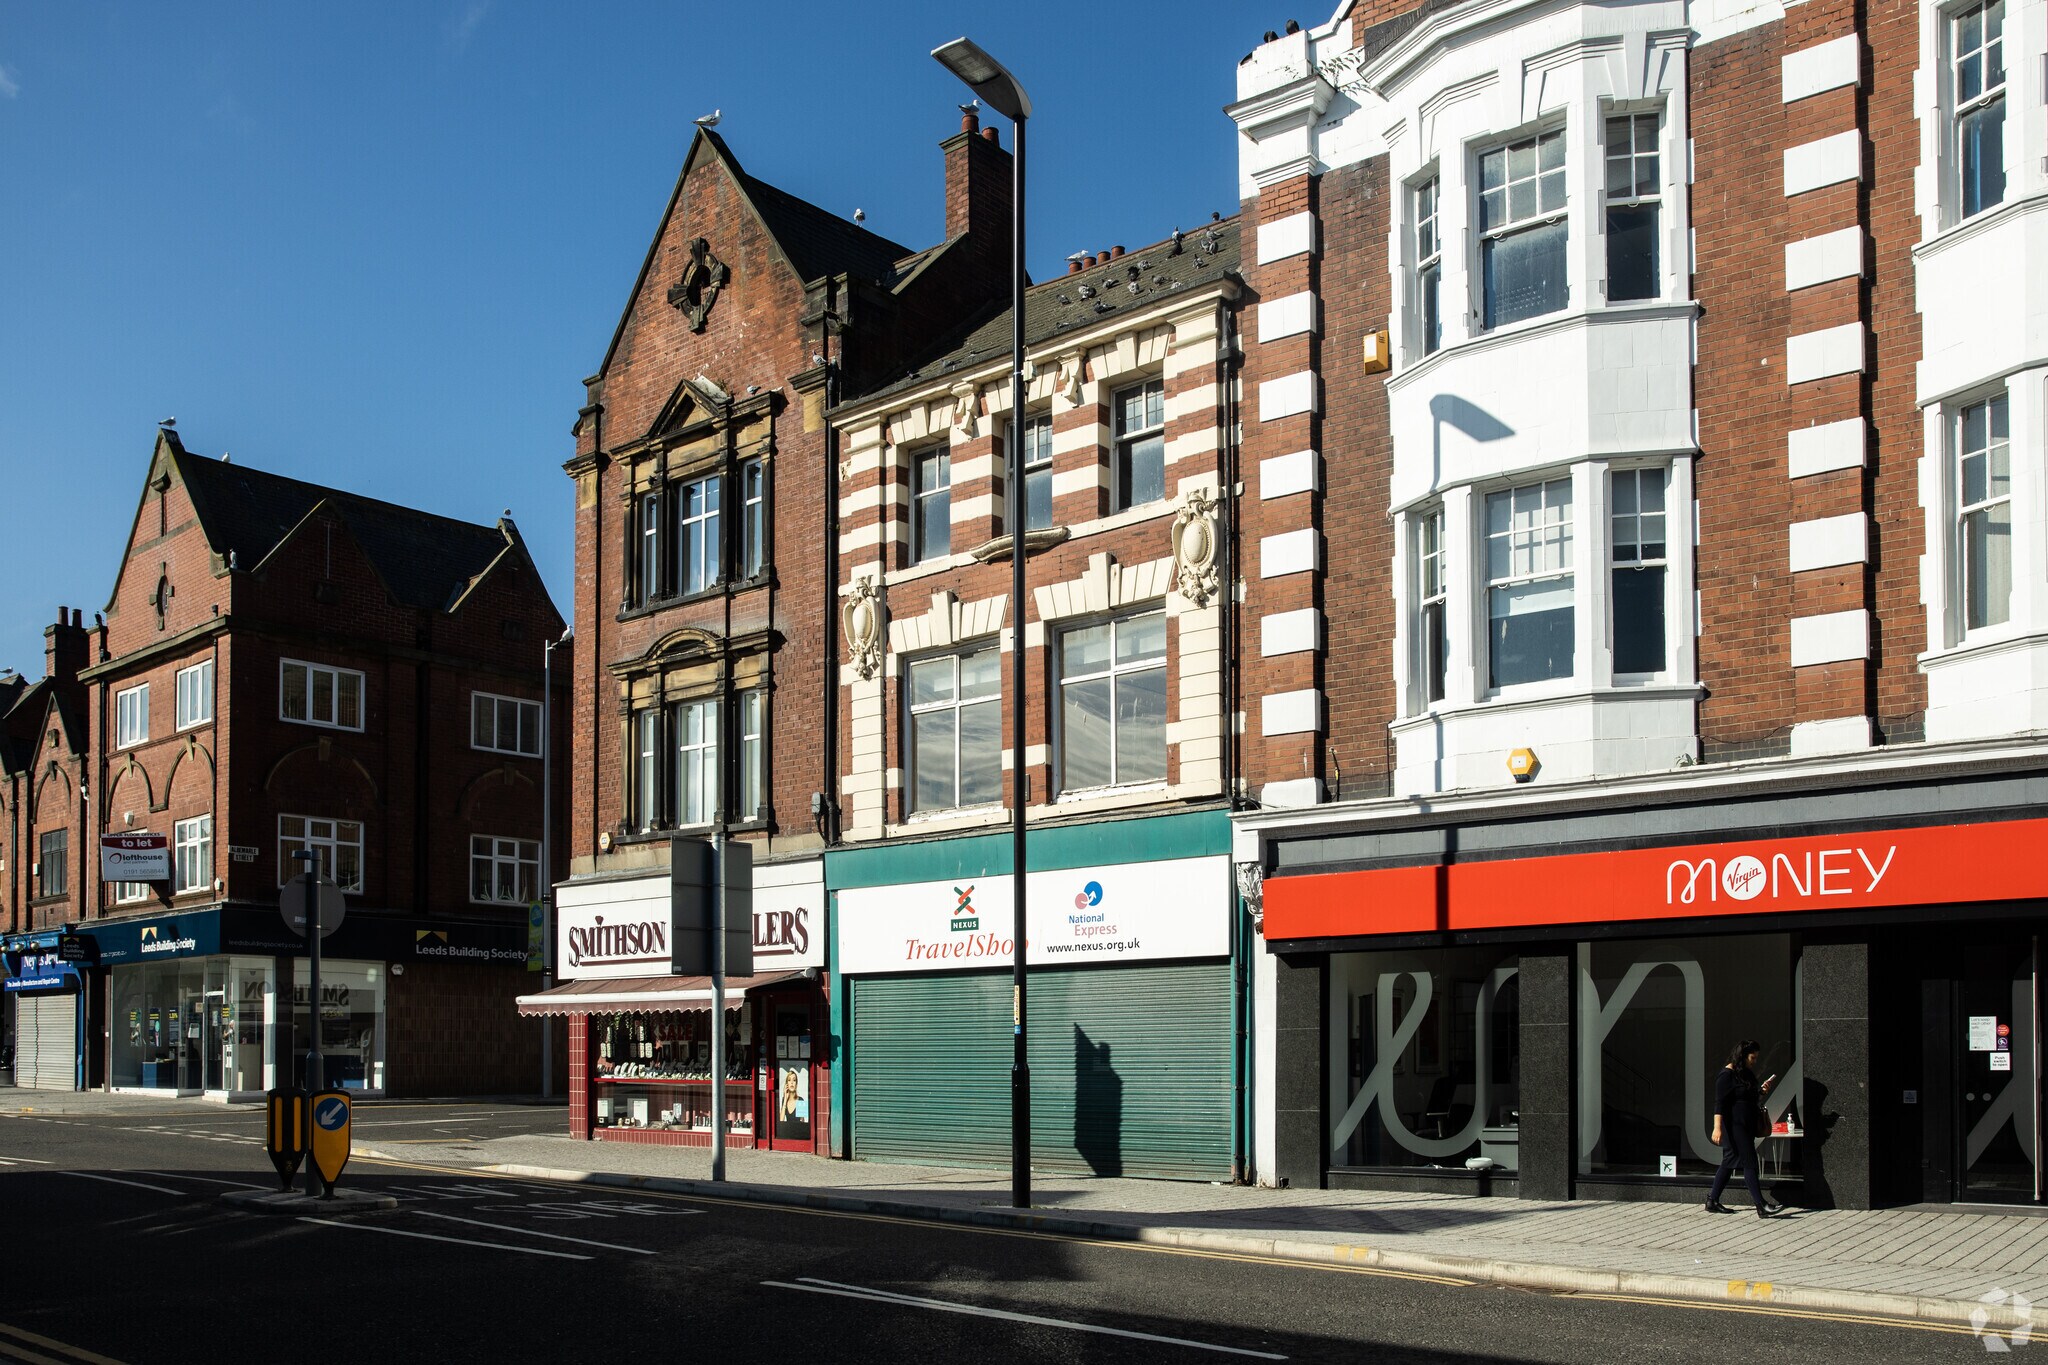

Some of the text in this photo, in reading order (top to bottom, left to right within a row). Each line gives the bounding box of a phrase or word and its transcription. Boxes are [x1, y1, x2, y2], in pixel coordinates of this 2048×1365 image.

[136, 839, 152, 847] let
[1666, 845, 1897, 904] MONEY
[1727, 862, 1762, 892] Virgin
[952, 920, 977, 929] NEXUS
[1068, 912, 1104, 924] National
[1074, 924, 1118, 938] Express
[142, 938, 196, 953] Leeds Building Society
[568, 915, 667, 967] SMITHSON
[906, 932, 1029, 960] TravelSho
[1046, 938, 1140, 953] www.nexus.org.uk
[416, 944, 528, 961] Leeds Building Society
[658, 1022, 693, 1041] SALE
